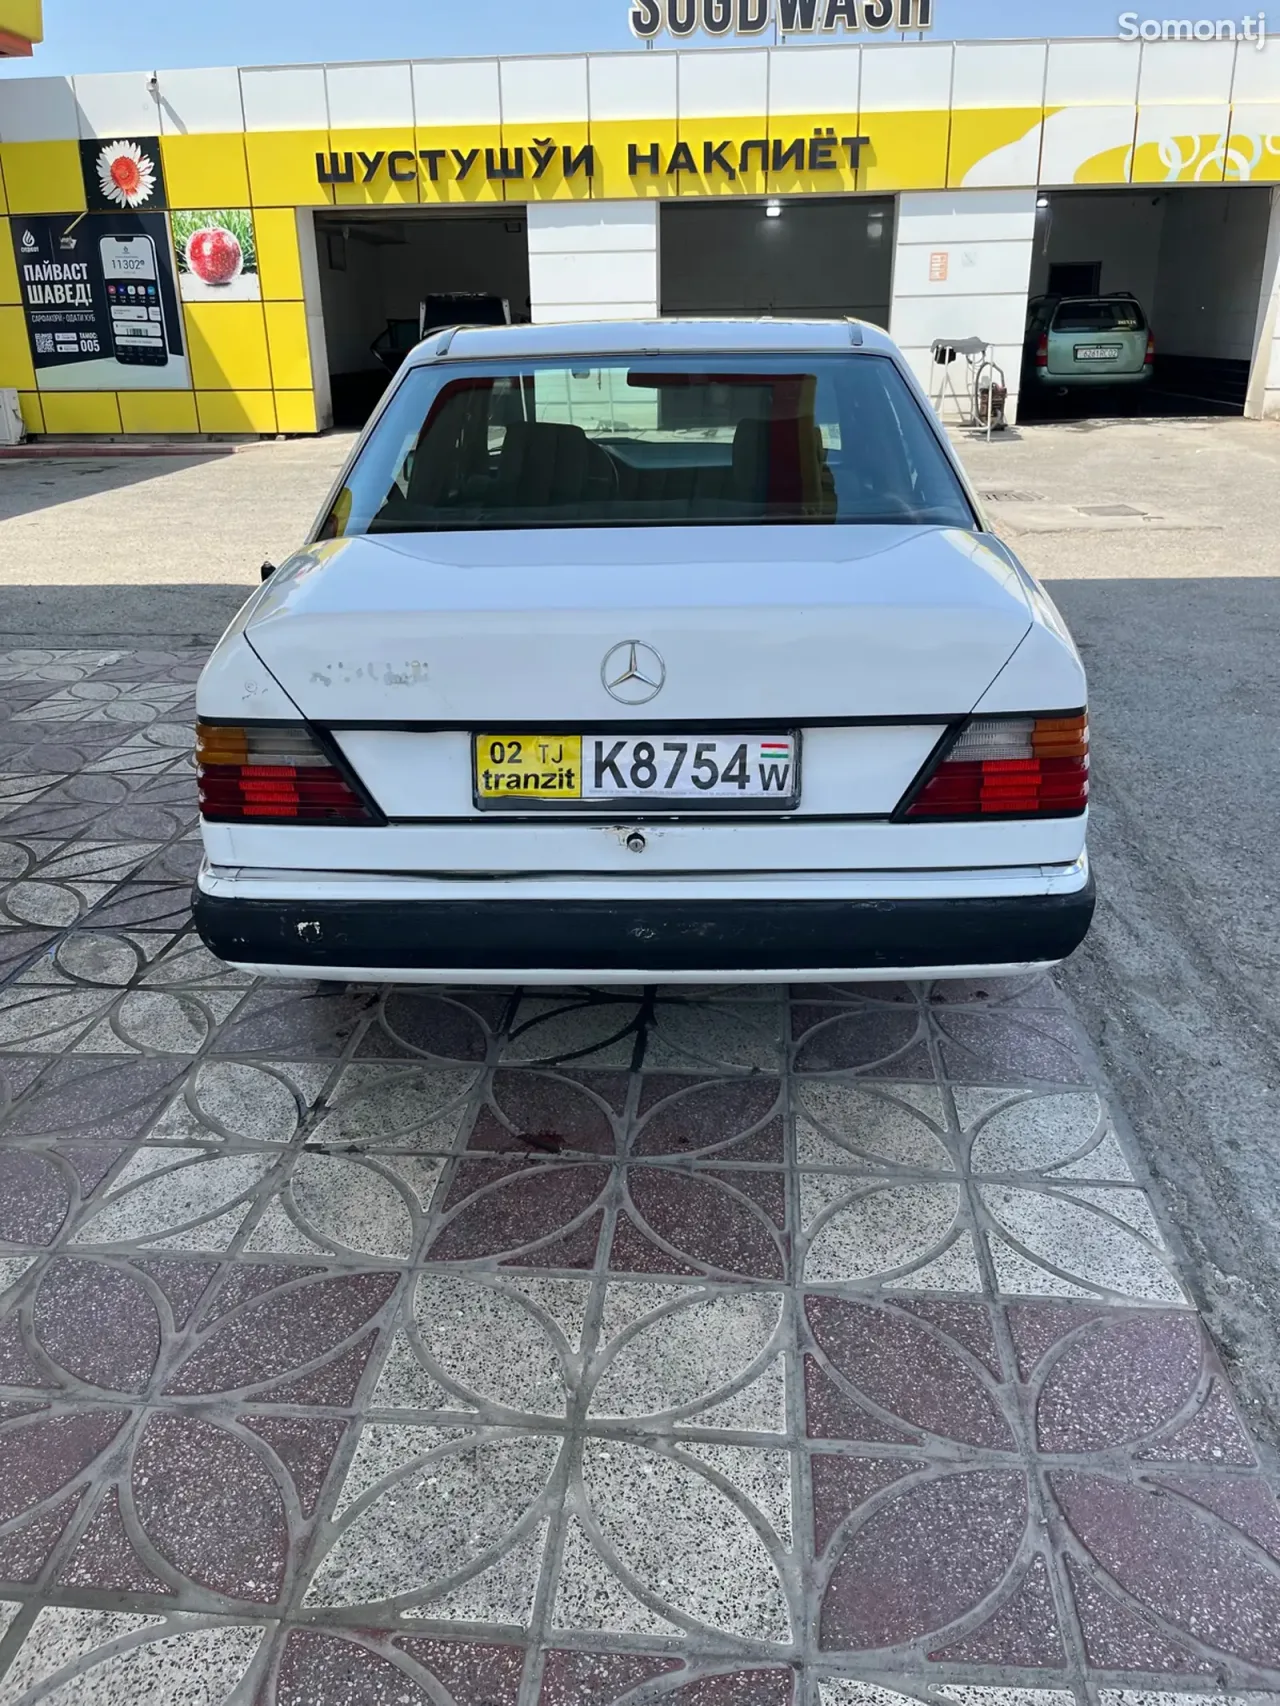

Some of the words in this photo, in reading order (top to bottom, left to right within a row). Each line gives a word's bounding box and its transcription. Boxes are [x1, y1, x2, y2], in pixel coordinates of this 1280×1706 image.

[627, 128, 870, 181] НАҚЛИЁТ
[23, 260, 88, 281] ПАЙВАСТ
[27, 283, 93, 306] ШАВЕД!
[80, 340, 100, 352] 005
[489, 741, 523, 764] 02
[538, 743, 563, 764] TJ
[594, 740, 750, 790] K8754
[758, 763, 789, 791] W
[482, 768, 575, 791] tranzit
